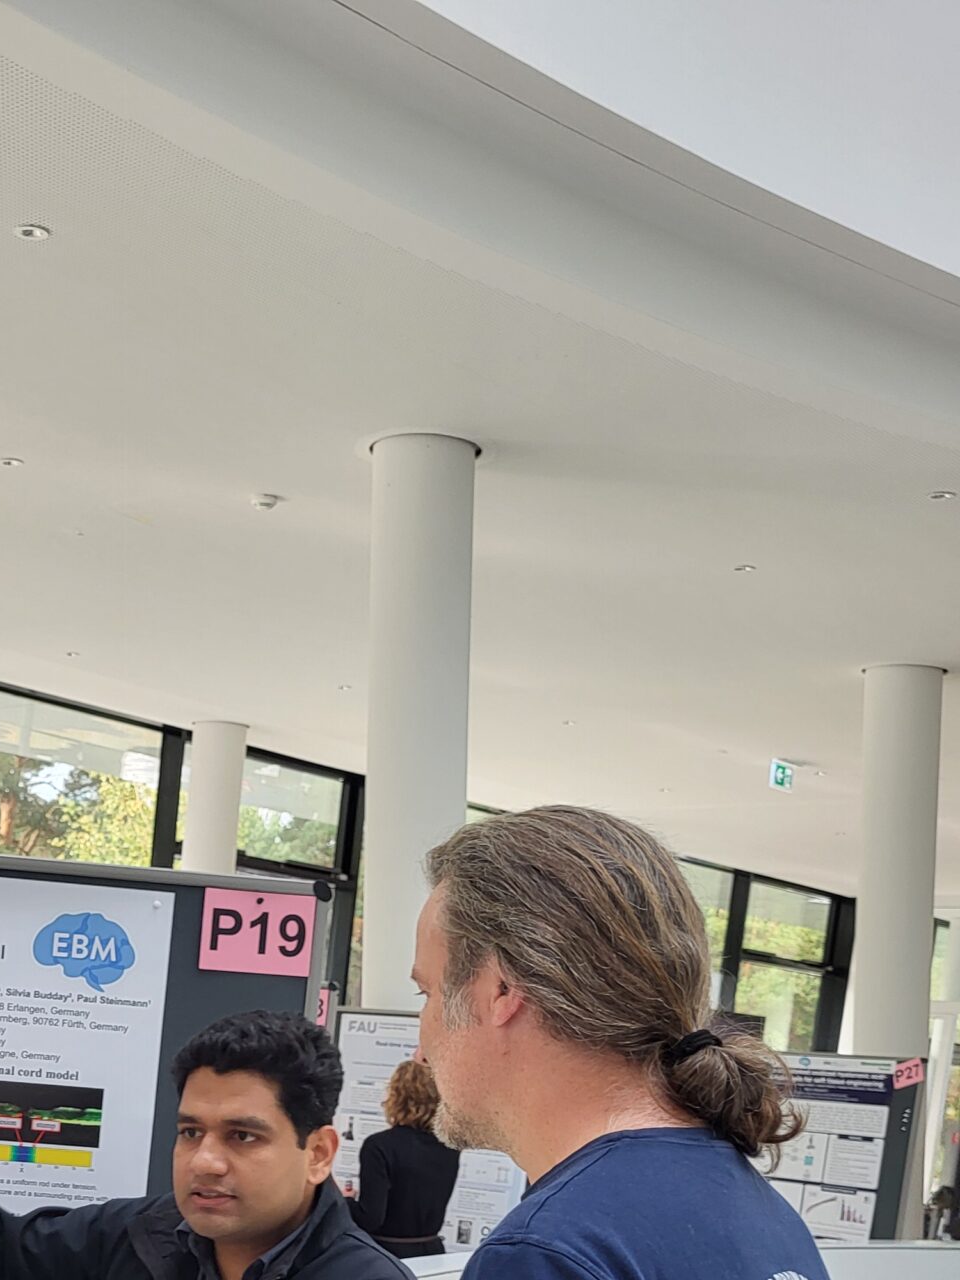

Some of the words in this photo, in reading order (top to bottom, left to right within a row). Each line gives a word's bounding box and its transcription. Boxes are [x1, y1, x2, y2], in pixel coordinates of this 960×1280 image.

[209, 907, 306, 957] P19
[52, 932, 117, 962] EBM
[7, 1003, 47, 1014] Erlangen,
[50, 1006, 90, 1018] Germany
[32, 1017, 59, 1026] 90762
[61, 1019, 86, 1029] Fürth,
[89, 1021, 128, 1033] Germany
[348, 1020, 377, 1034] FAU
[21, 1050, 60, 1062] Germany
[17, 1068, 42, 1077] cord
[45, 1070, 78, 1080] model
[895, 1064, 920, 1083] P27
